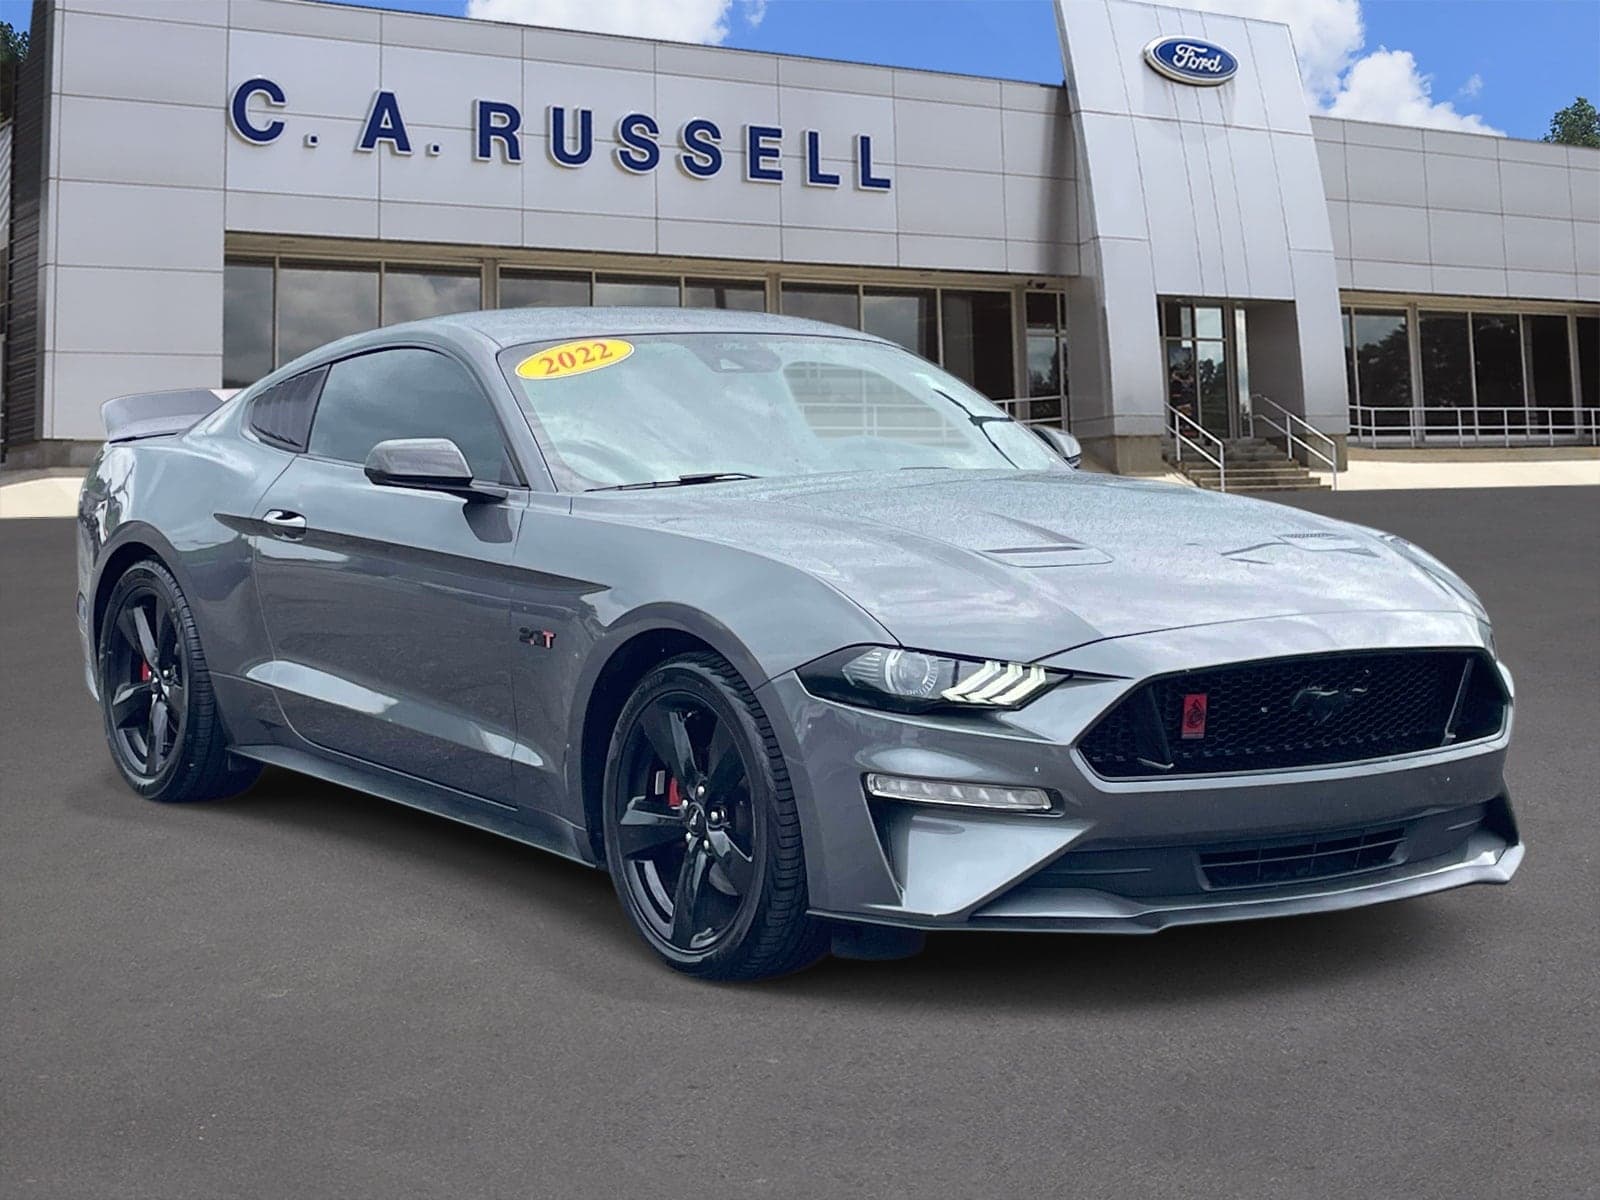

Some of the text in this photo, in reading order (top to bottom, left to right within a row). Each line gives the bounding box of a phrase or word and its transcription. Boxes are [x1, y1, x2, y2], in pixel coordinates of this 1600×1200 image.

[1172, 43, 1223, 72] Ford
[475, 99, 892, 191] RUSSELL
[540, 342, 614, 375] 2022
